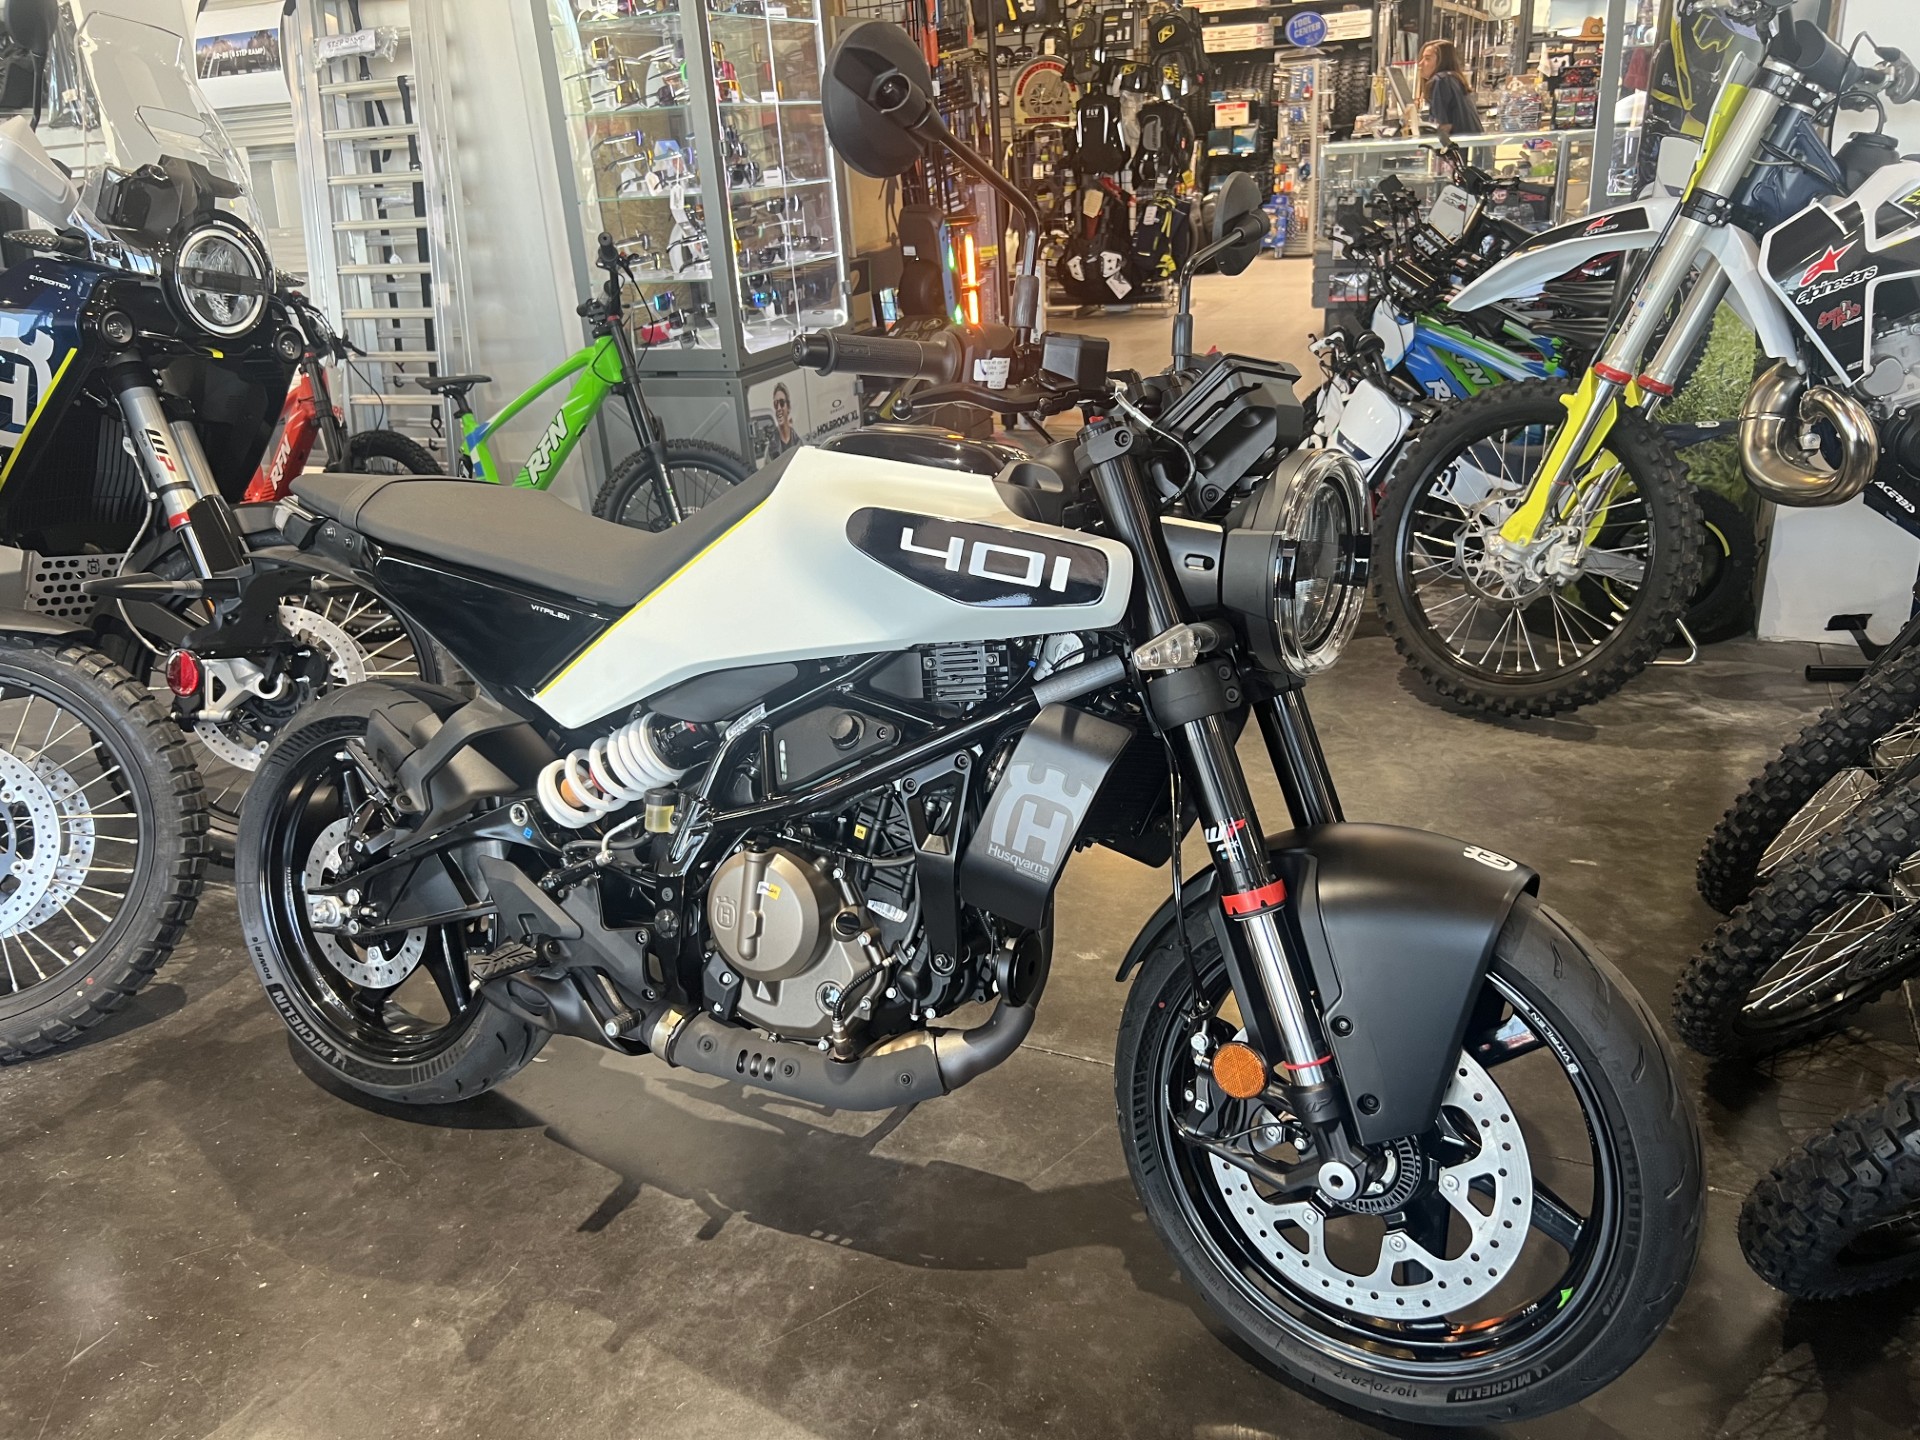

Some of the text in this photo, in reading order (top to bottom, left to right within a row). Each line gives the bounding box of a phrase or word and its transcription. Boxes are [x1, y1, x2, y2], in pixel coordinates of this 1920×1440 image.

[1293, 14, 1312, 28] TOOL
[1294, 21, 1321, 38] CENTER
[235, 48, 247, 58] STEP
[1086, 108, 1099, 116] FLY
[1524, 138, 1544, 150] VP
[1412, 233, 1438, 256] RFN
[28, 274, 71, 290] EXPEDITION
[788, 284, 806, 306] pnt
[1796, 265, 1879, 305] alpinestars
[1621, 313, 1638, 336] XACT
[1451, 353, 1492, 385] FN
[817, 412, 850, 435] HOLBROOK
[525, 409, 569, 485] RFN
[270, 433, 291, 491] RFN
[1874, 481, 1915, 513] ACERBIS
[900, 527, 1071, 592] 401
[530, 604, 570, 621] VITPILEN
[988, 843, 1050, 877] Husqvarna
[255, 946, 273, 980] POWER
[272, 989, 333, 1058] MICHELIN
[1530, 1012, 1571, 1062] VITPILEN
[1333, 1367, 1418, 1399] 110/70 ZR 17
[1454, 1373, 1532, 1401] MICHELIN
